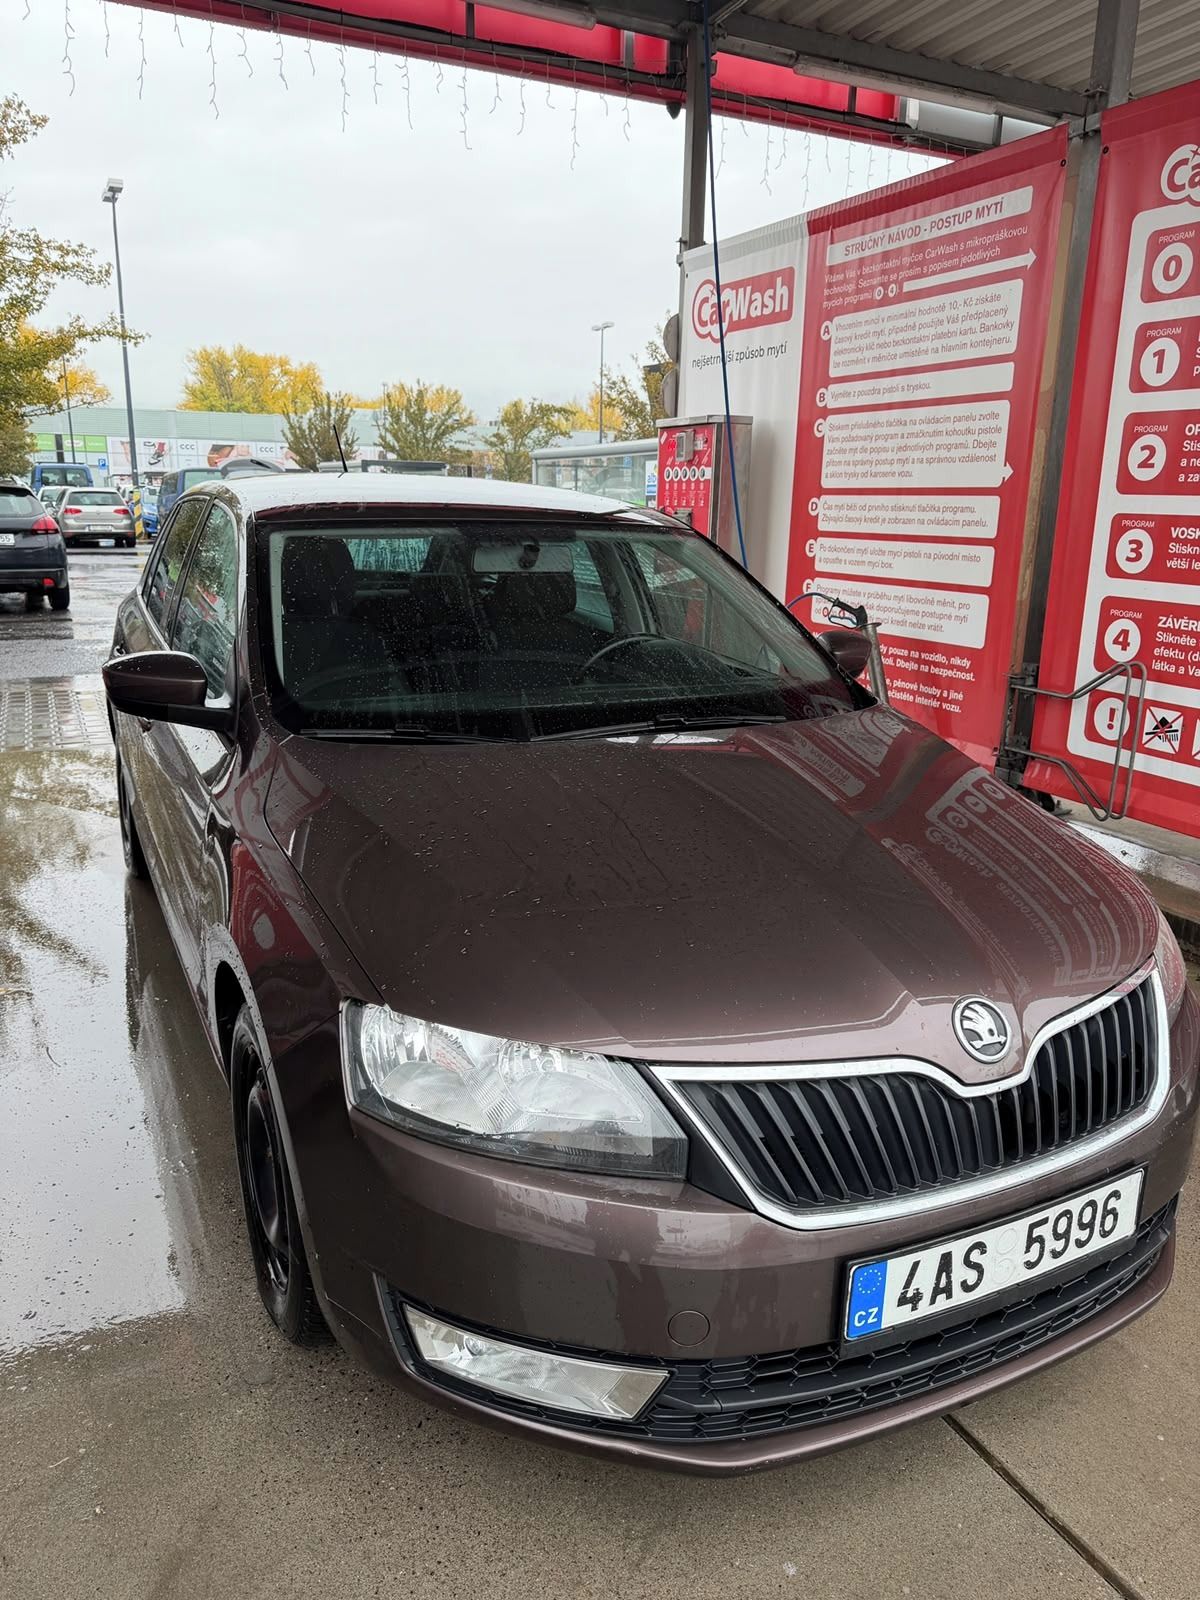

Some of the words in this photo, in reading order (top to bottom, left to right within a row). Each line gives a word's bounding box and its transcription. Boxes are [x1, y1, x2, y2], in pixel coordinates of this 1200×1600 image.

[844, 232, 885, 256] STRUČNÝ
[887, 225, 921, 244] NÁVOD
[929, 210, 972, 233] POSTUP
[975, 197, 1004, 220] MYTÍ
[1159, 230, 1195, 244] PROGRAM
[862, 257, 901, 275] bezkontaktní
[902, 253, 923, 266] myčce
[925, 242, 958, 259] CarWash
[966, 226, 1028, 248] mikropráškovou
[898, 267, 921, 280] prosím
[928, 258, 959, 274] popisem
[1162, 254, 1182, 281] 0
[697, 277, 789, 328] CarWash
[918, 303, 946, 317] hodnotě
[963, 298, 973, 308] Kč
[974, 292, 1002, 305] získáte
[946, 313, 960, 325] Váš
[961, 304, 1009, 322] předplacený
[823, 325, 830, 336] A
[930, 326, 957, 343] platební
[979, 319, 1015, 333] Bankovky
[1146, 326, 1182, 338] PROGRAM
[930, 346, 939, 354] na
[941, 341, 968, 353] hlavním
[969, 335, 1012, 349] kontejneru.
[692, 350, 734, 369] nejšetrnjší
[735, 345, 765, 364] způsob
[766, 340, 787, 358] mytí
[1153, 349, 1165, 374] 1
[819, 392, 826, 402] B
[908, 418, 917, 426] na
[918, 415, 952, 425] ovládacím
[953, 412, 977, 425] panelu
[978, 410, 1000, 421] zvolte
[816, 422, 823, 433] C
[945, 425, 976, 436] kohoutku
[978, 425, 1002, 437] pistole
[1133, 424, 1168, 433] PROGRAM
[935, 440, 970, 453] programů.
[972, 439, 997, 451] Dbejte
[925, 455, 957, 466] správnou
[958, 453, 997, 463] vzdálenost
[1137, 444, 1157, 469] 2
[1180, 458, 1187, 467] a
[1178, 473, 1185, 482] a
[811, 502, 818, 511] D
[941, 505, 977, 515] programu.
[887, 516, 915, 525] zobrazen
[916, 518, 925, 526] na
[926, 517, 960, 527] ovládacím
[961, 518, 989, 528] panelu.
[1121, 519, 1155, 528] PROGRAM
[808, 543, 815, 553] E
[1125, 539, 1144, 563] 3
[923, 552, 932, 560] na
[933, 551, 960, 562] původní
[961, 552, 981, 563] místo
[1166, 557, 1190, 569] větší
[806, 583, 811, 592] F
[906, 594, 935, 606] libovolně
[958, 602, 971, 611] pro
[921, 610, 952, 621] postupné
[954, 614, 969, 624] mytí
[1110, 608, 1143, 619] PROGRAM
[1112, 628, 1131, 651] 4
[1155, 630, 1197, 647] Stikněte
[888, 646, 908, 657] pouze
[910, 650, 919, 658] na
[920, 652, 949, 665] vozidlo,
[950, 656, 971, 669] nikdy
[1153, 647, 1185, 660] efektu
[896, 658, 918, 671] Dbejte
[919, 665, 929, 673] na
[930, 665, 975, 682] bezpečnost.
[1151, 659, 1176, 673] látka
[1178, 666, 1185, 675] a
[893, 679, 918, 691] pěnové
[919, 683, 941, 697] houby
[942, 689, 948, 697] a
[948, 689, 964, 701] jiné
[915, 694, 940, 708] interiér
[942, 703, 962, 713] vozu.
[896, 1240, 988, 1312] 4AS
[1023, 1189, 1122, 1271] 5996
[853, 1307, 878, 1327] CZ
